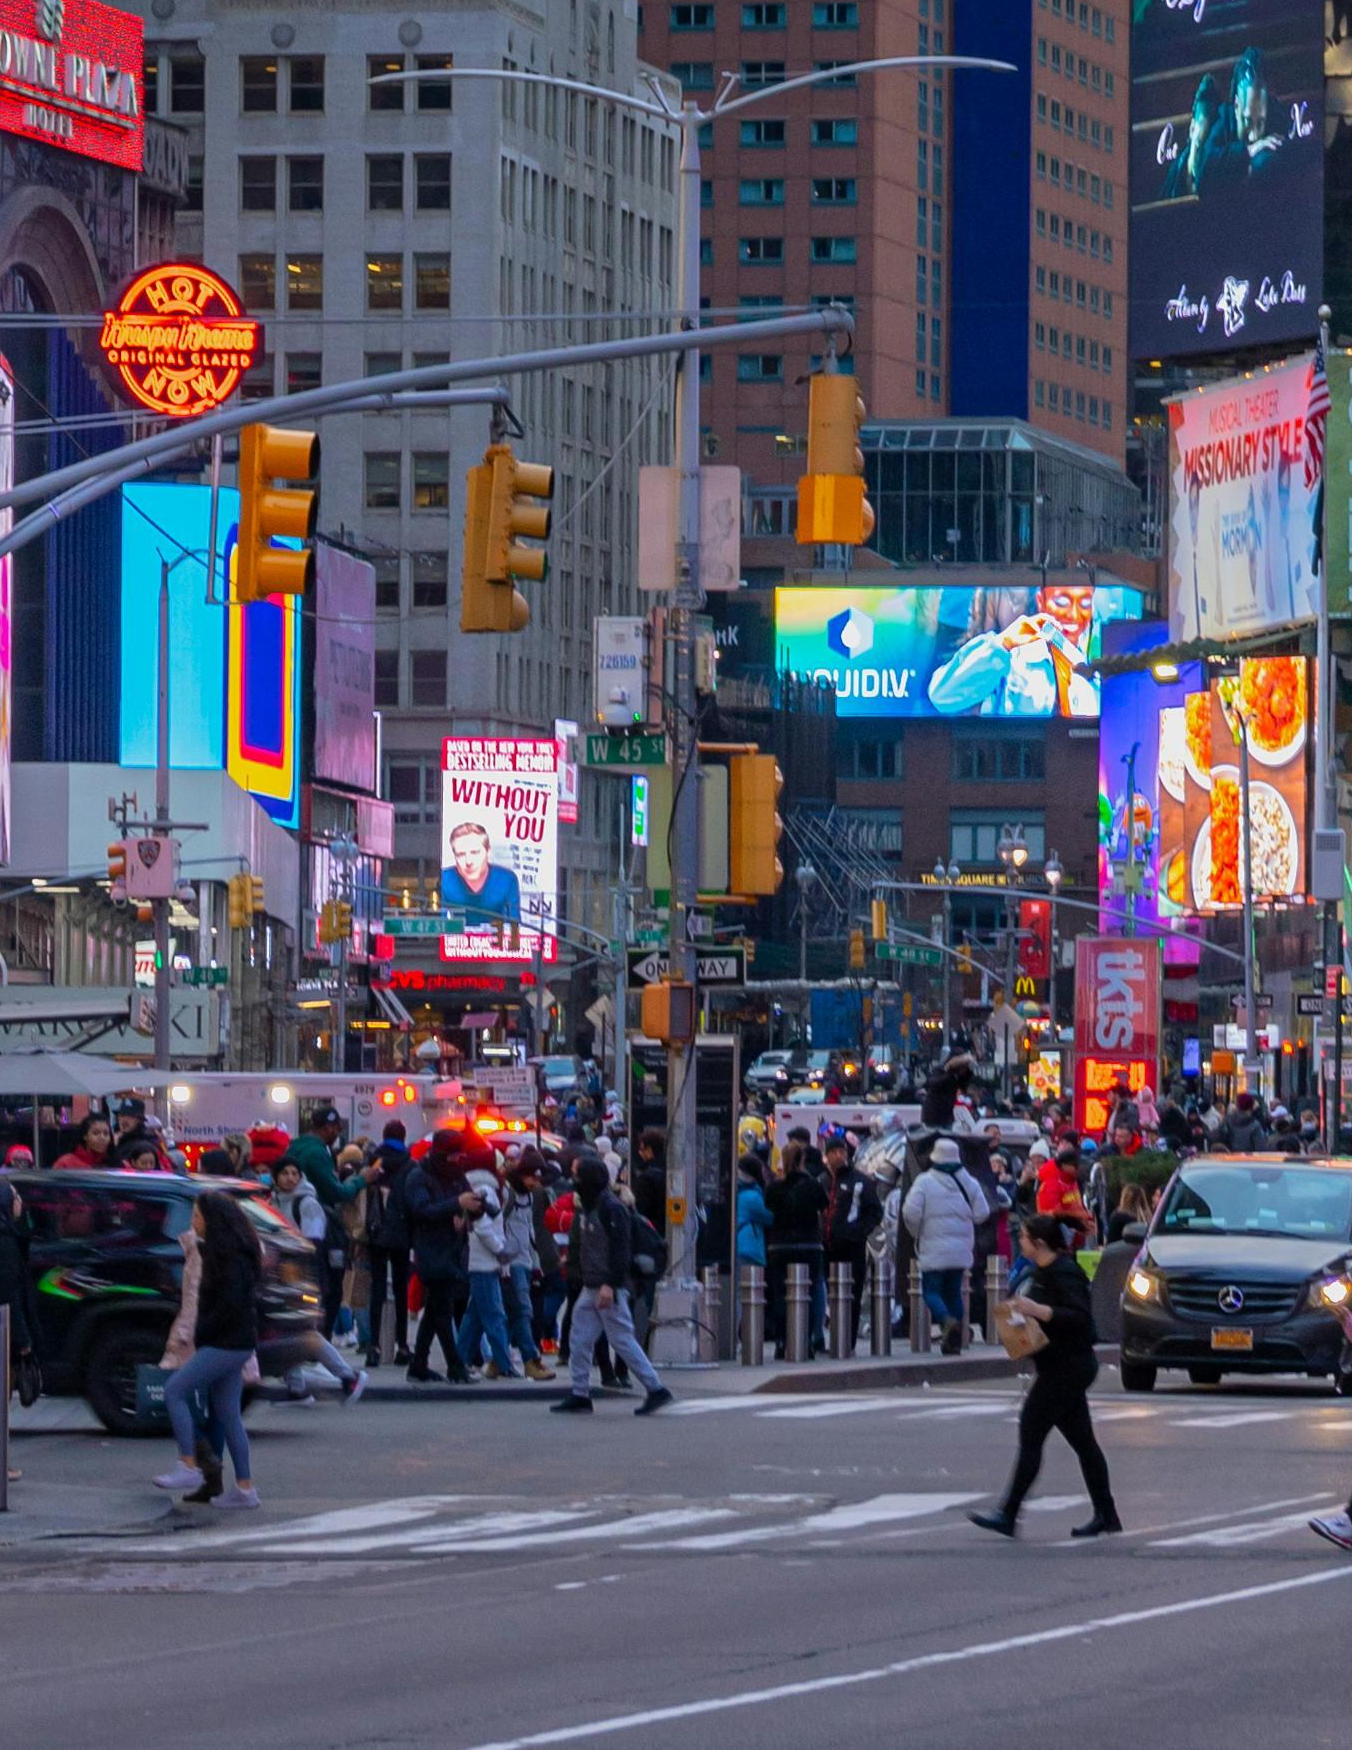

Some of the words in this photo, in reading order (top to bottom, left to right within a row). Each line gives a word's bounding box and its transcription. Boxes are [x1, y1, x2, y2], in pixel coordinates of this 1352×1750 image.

[64, 51, 140, 117] PLAZA
[23, 102, 73, 139] HOTEL
[145, 276, 215, 314] HOT
[107, 352, 184, 365] ORIGINAL
[190, 353, 251, 367] GLAZED
[143, 368, 218, 405] NOW
[1183, 430, 1260, 494] MISSIONARY
[1260, 417, 1304, 472] STYLE
[447, 752, 513, 771] BESTSELLING
[592, 735, 609, 762] W
[619, 735, 643, 762] 45
[451, 777, 552, 817] WITHOUT
[504, 812, 546, 843] YOU
[427, 973, 507, 992] pharmacy
[1096, 947, 1146, 1051] tkts
[183, 1122, 217, 1136] North
